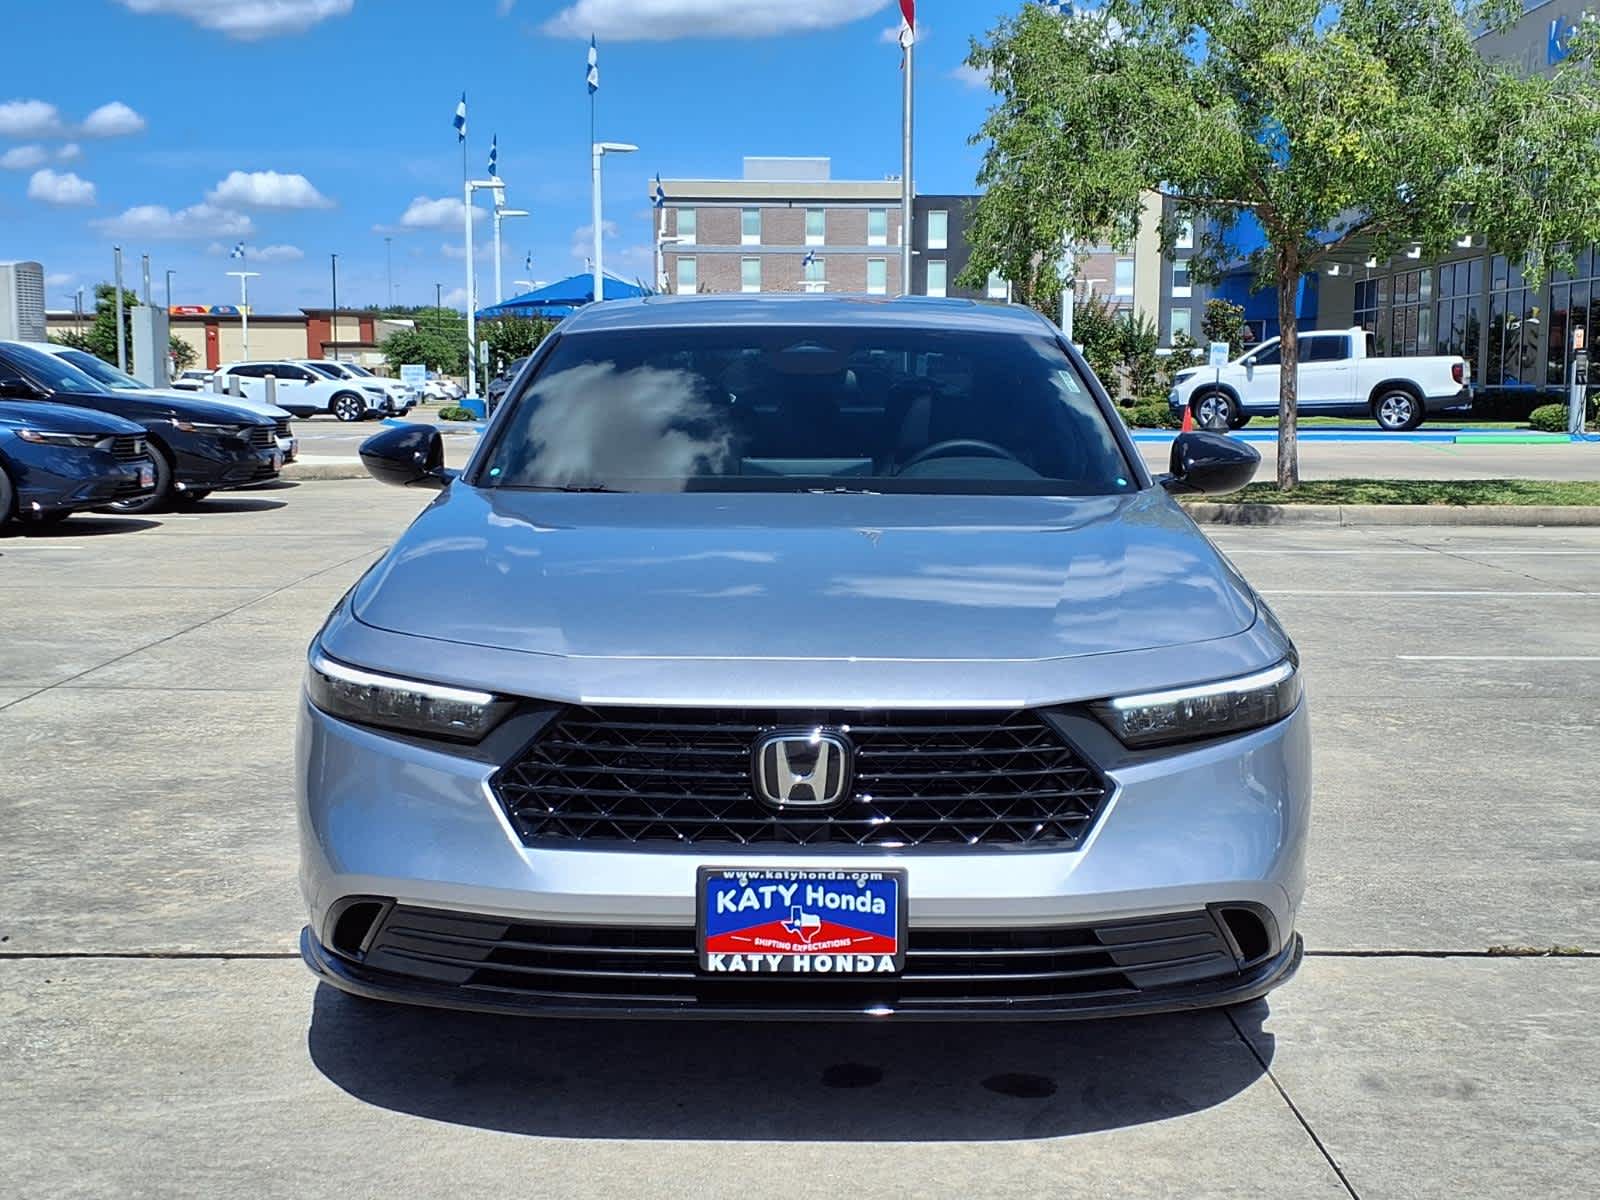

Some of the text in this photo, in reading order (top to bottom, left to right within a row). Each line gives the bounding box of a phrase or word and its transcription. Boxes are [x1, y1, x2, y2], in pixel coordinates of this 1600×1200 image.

[722, 870, 883, 881] www.katyhonda.com
[716, 883, 886, 915] KATY Honda
[754, 937, 851, 952] SHIFTING EXPECTATIONS
[707, 954, 896, 973] KATY HONDA
